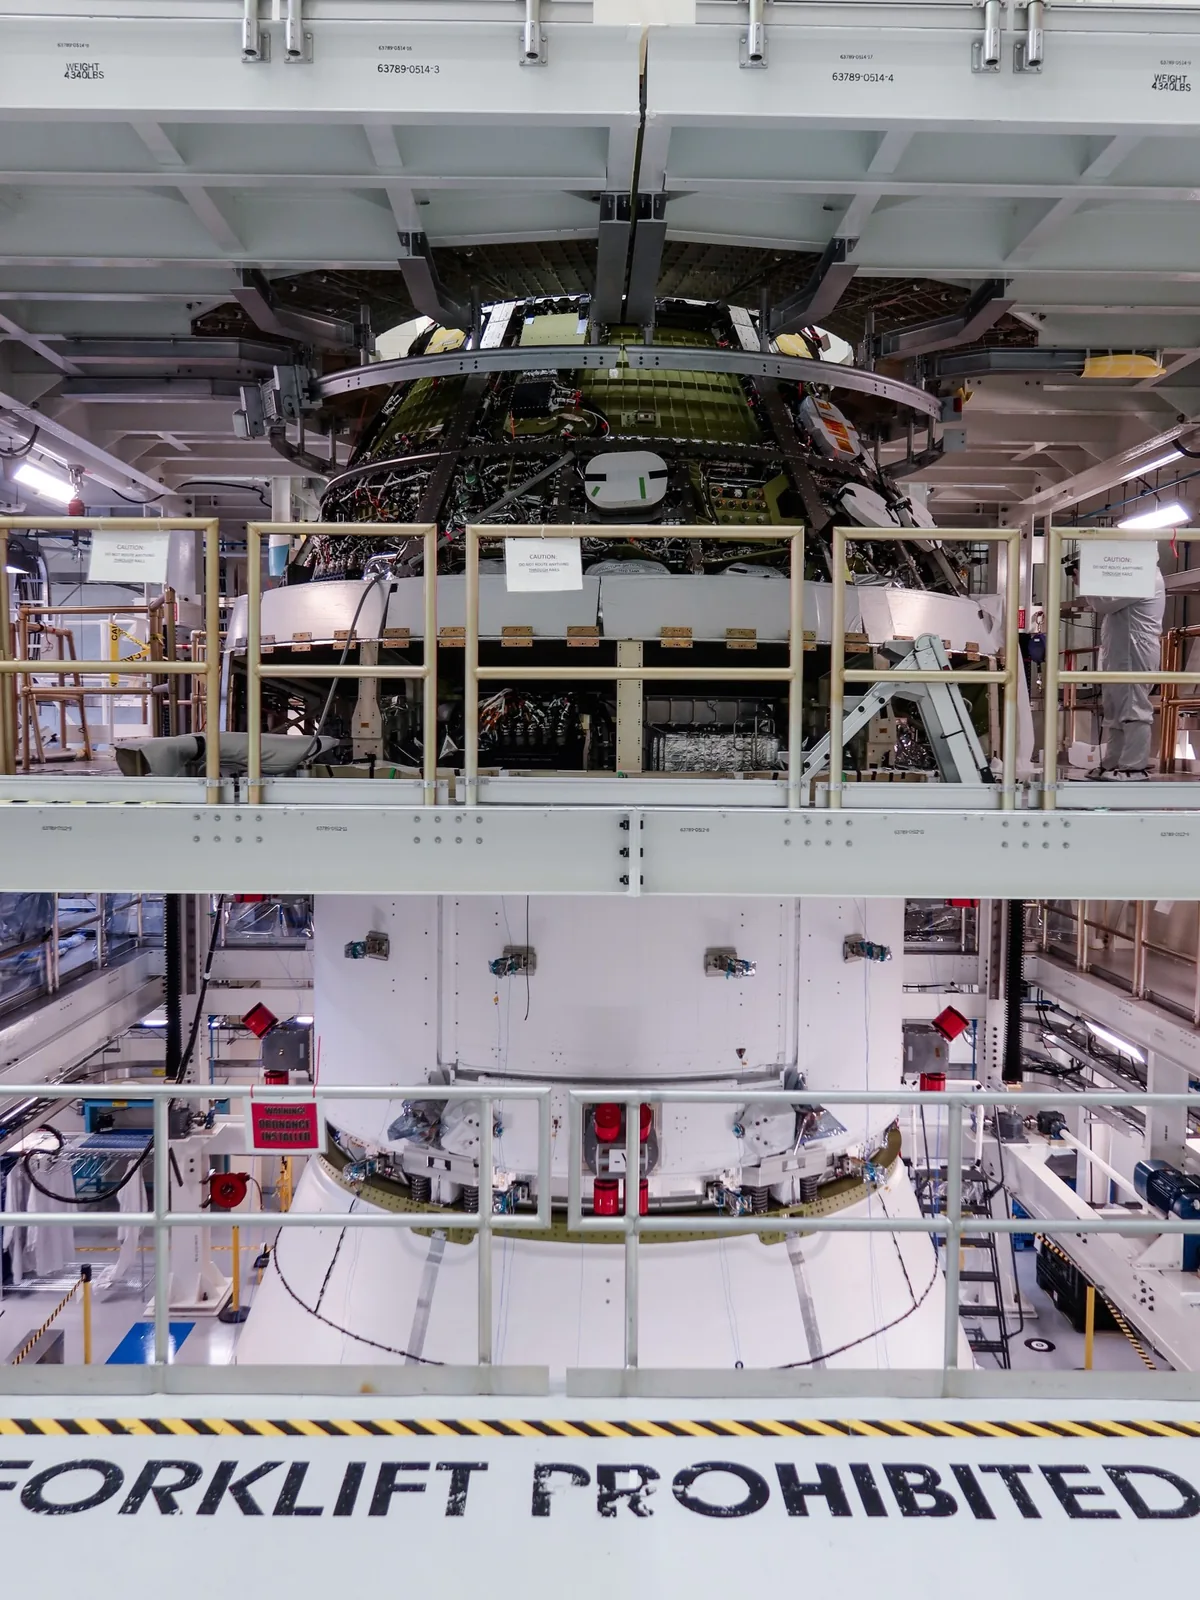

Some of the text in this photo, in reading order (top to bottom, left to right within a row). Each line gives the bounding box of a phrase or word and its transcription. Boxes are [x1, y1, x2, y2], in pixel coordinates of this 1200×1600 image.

[66, 62, 100, 71] WEIGHT
[377, 63, 440, 74] 63789-0514-3
[64, 70, 105, 79] 4340LBS
[832, 72, 894, 82] 63789-0514-4
[1154, 74, 1188, 83] WEIGHT
[1151, 81, 1191, 92] 4340LBS
[262, 1132, 310, 1142] INSTALLED
[531, 1461, 1200, 1520] PROHIBITED
